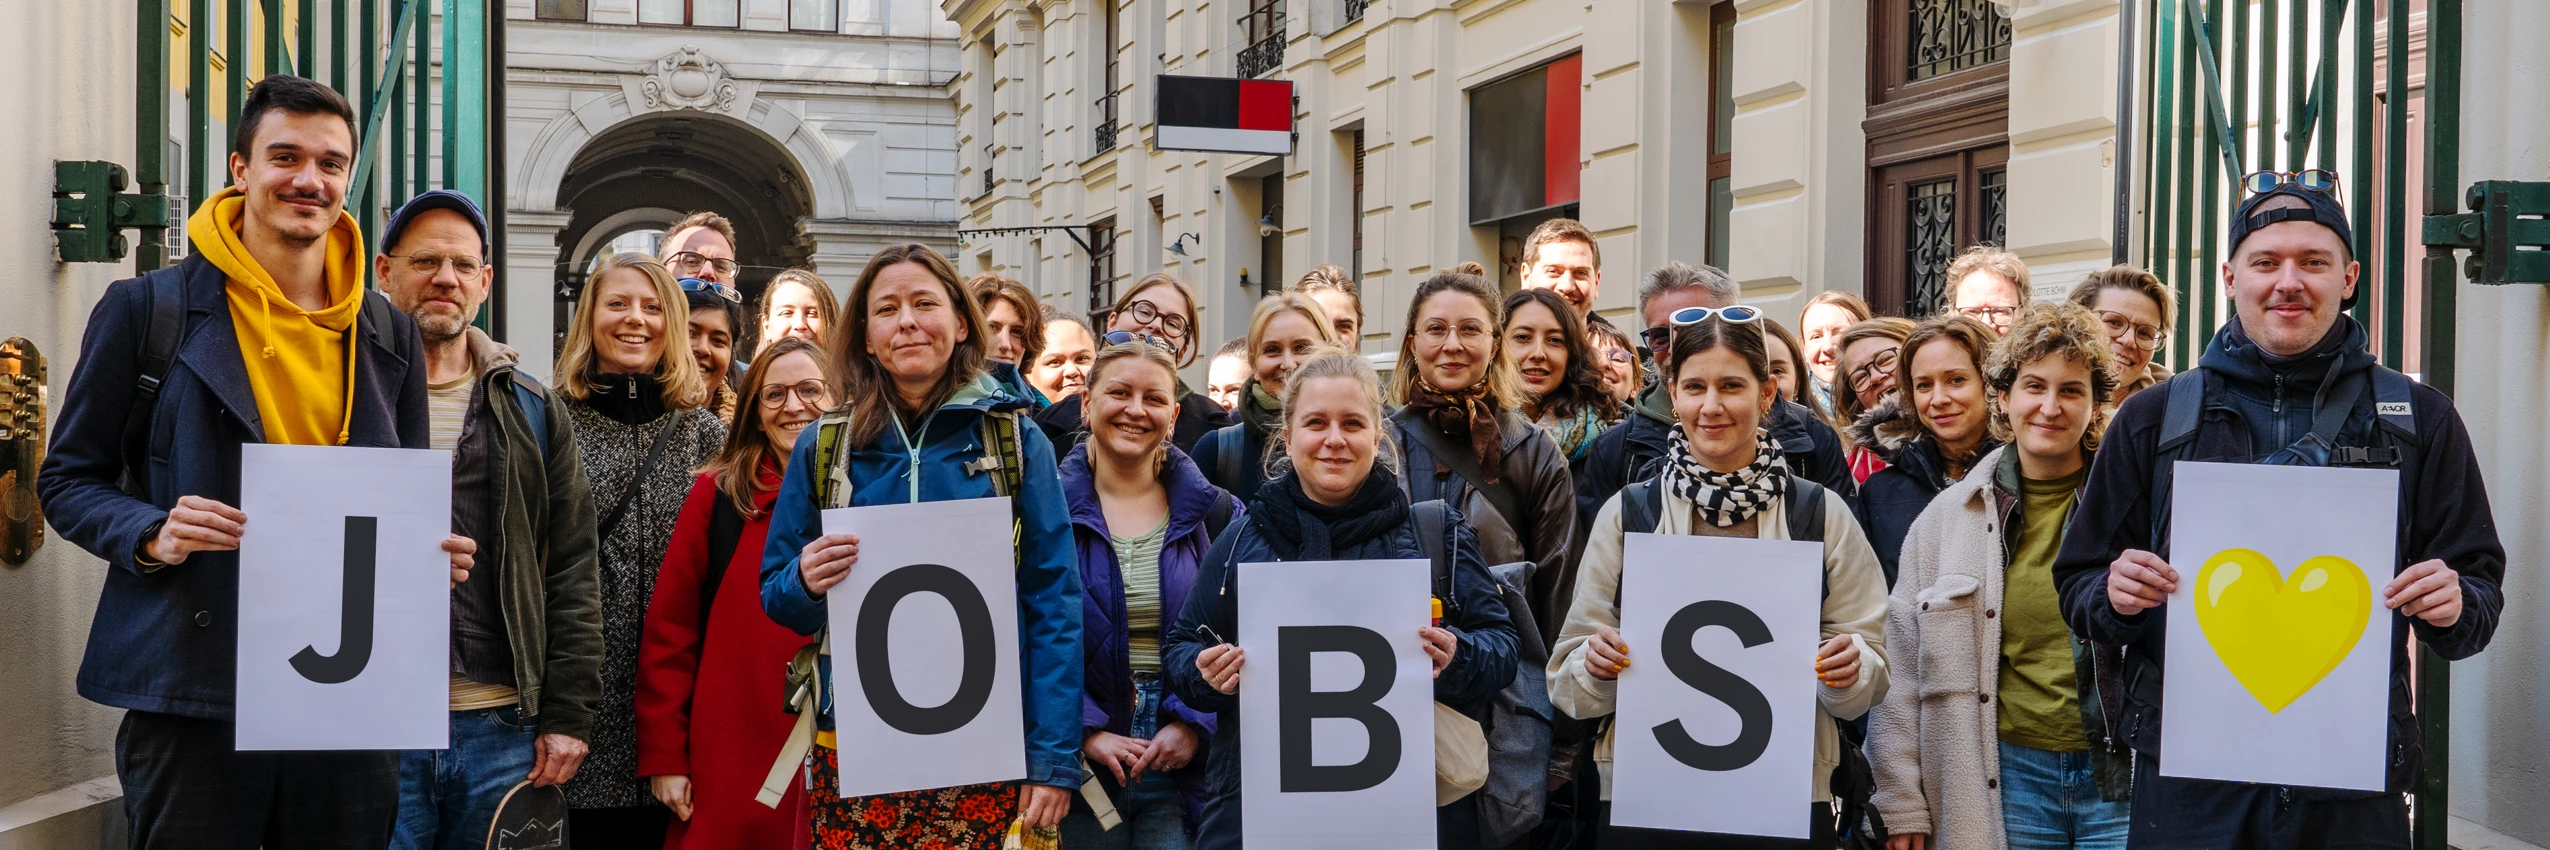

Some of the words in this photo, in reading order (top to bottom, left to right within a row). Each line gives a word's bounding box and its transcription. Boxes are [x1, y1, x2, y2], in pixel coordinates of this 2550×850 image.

[2032, 286, 2050, 297] LOTTE
[2051, 285, 2067, 296] BÖHM
[288, 515, 378, 685] J
[855, 563, 997, 736] O
[1277, 625, 1402, 794] B
[1651, 599, 1775, 772] S
